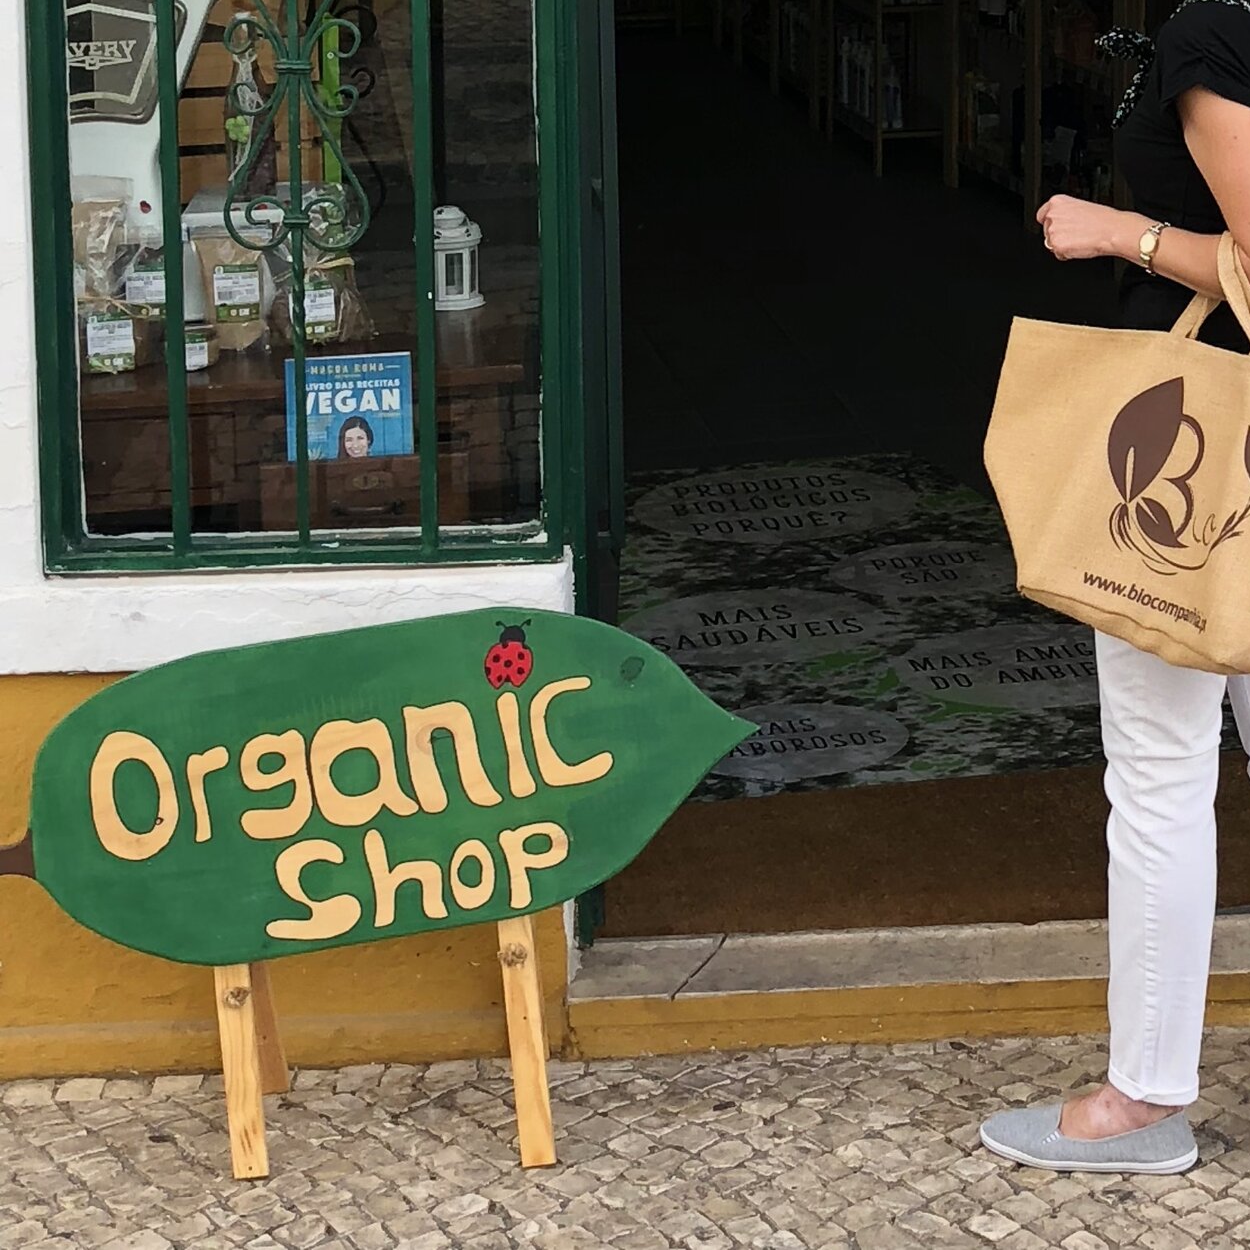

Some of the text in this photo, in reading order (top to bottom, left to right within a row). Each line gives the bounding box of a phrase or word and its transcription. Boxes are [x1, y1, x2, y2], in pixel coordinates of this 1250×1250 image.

[68, 40, 137, 59] VERY
[335, 380, 354, 389] DAS
[357, 378, 401, 389] RECEITAS
[672, 473, 847, 499] PRODUTOS
[671, 488, 872, 517] BIOLÓGICOS
[870, 549, 986, 572] PORQUE
[904, 565, 959, 585] SÃO
[698, 604, 793, 627] MAIS
[651, 617, 864, 652] SAUDÁVEIS
[908, 642, 1094, 673] MAIS AMIG
[930, 661, 1097, 691] DO AMBIE
[729, 729, 887, 759] ABOROSOS
[89, 676, 614, 862] Organic
[265, 820, 570, 940] Shop
